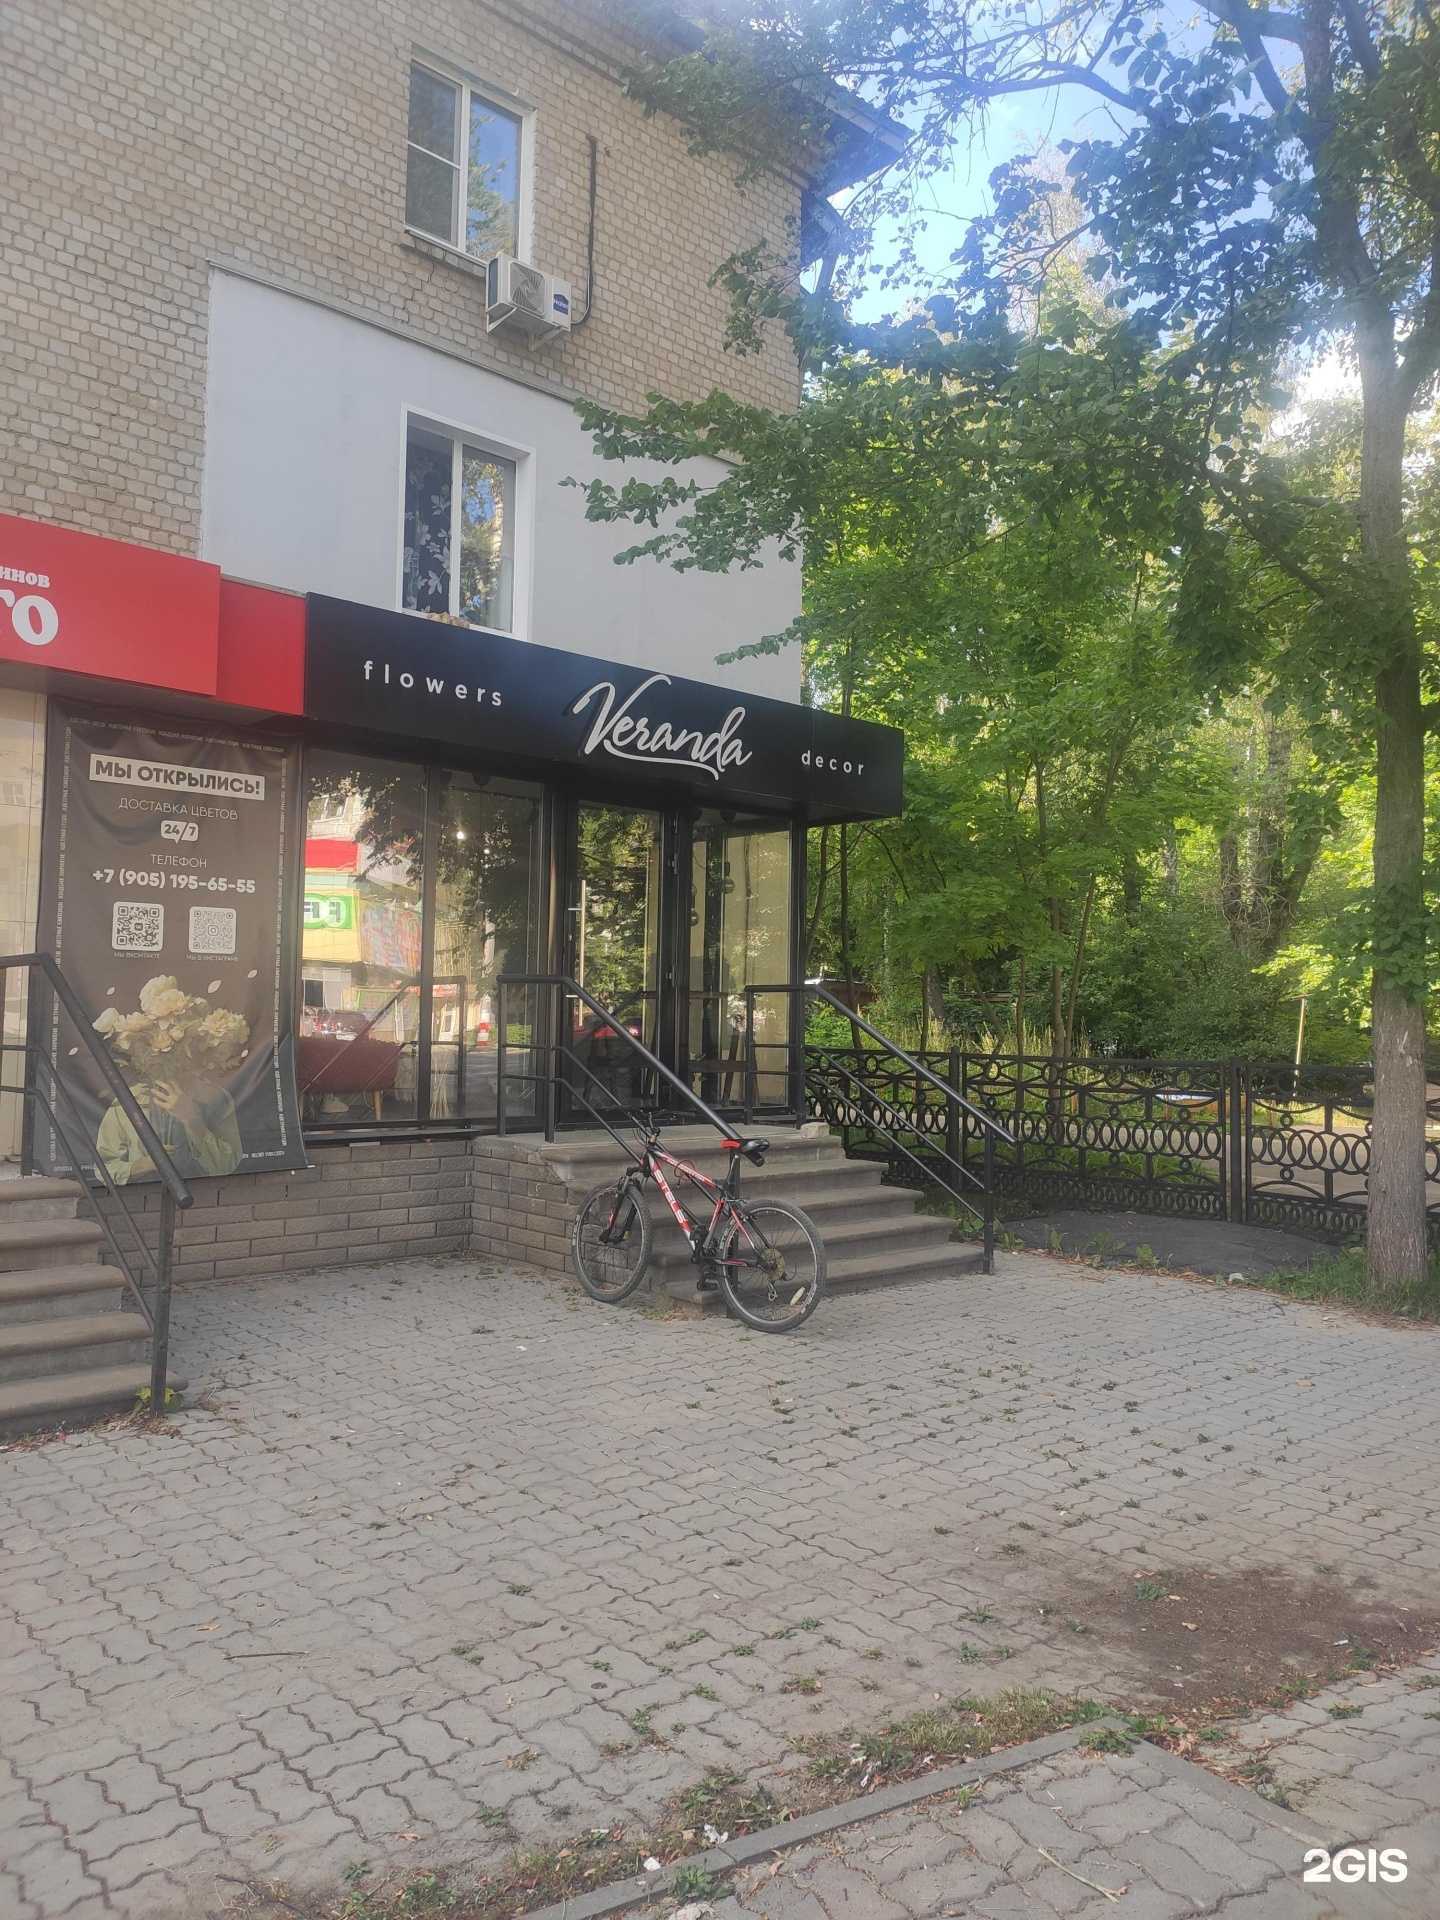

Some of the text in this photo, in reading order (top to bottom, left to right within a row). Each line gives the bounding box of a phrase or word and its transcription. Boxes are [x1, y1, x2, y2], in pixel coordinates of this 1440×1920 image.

[364, 660, 502, 706] flowers
[572, 674, 752, 781] Veranda
[801, 750, 864, 775] decor
[95, 759, 260, 795] МЫ ОТКРЫЛИСЬ!
[118, 798, 239, 820] ДОСТАВКА ЦВЕТОВ
[163, 821, 198, 840] 24/7
[150, 854, 207, 868] ТЕЛЕФОН
[92, 868, 256, 894] +7 (905) 195-65-55
